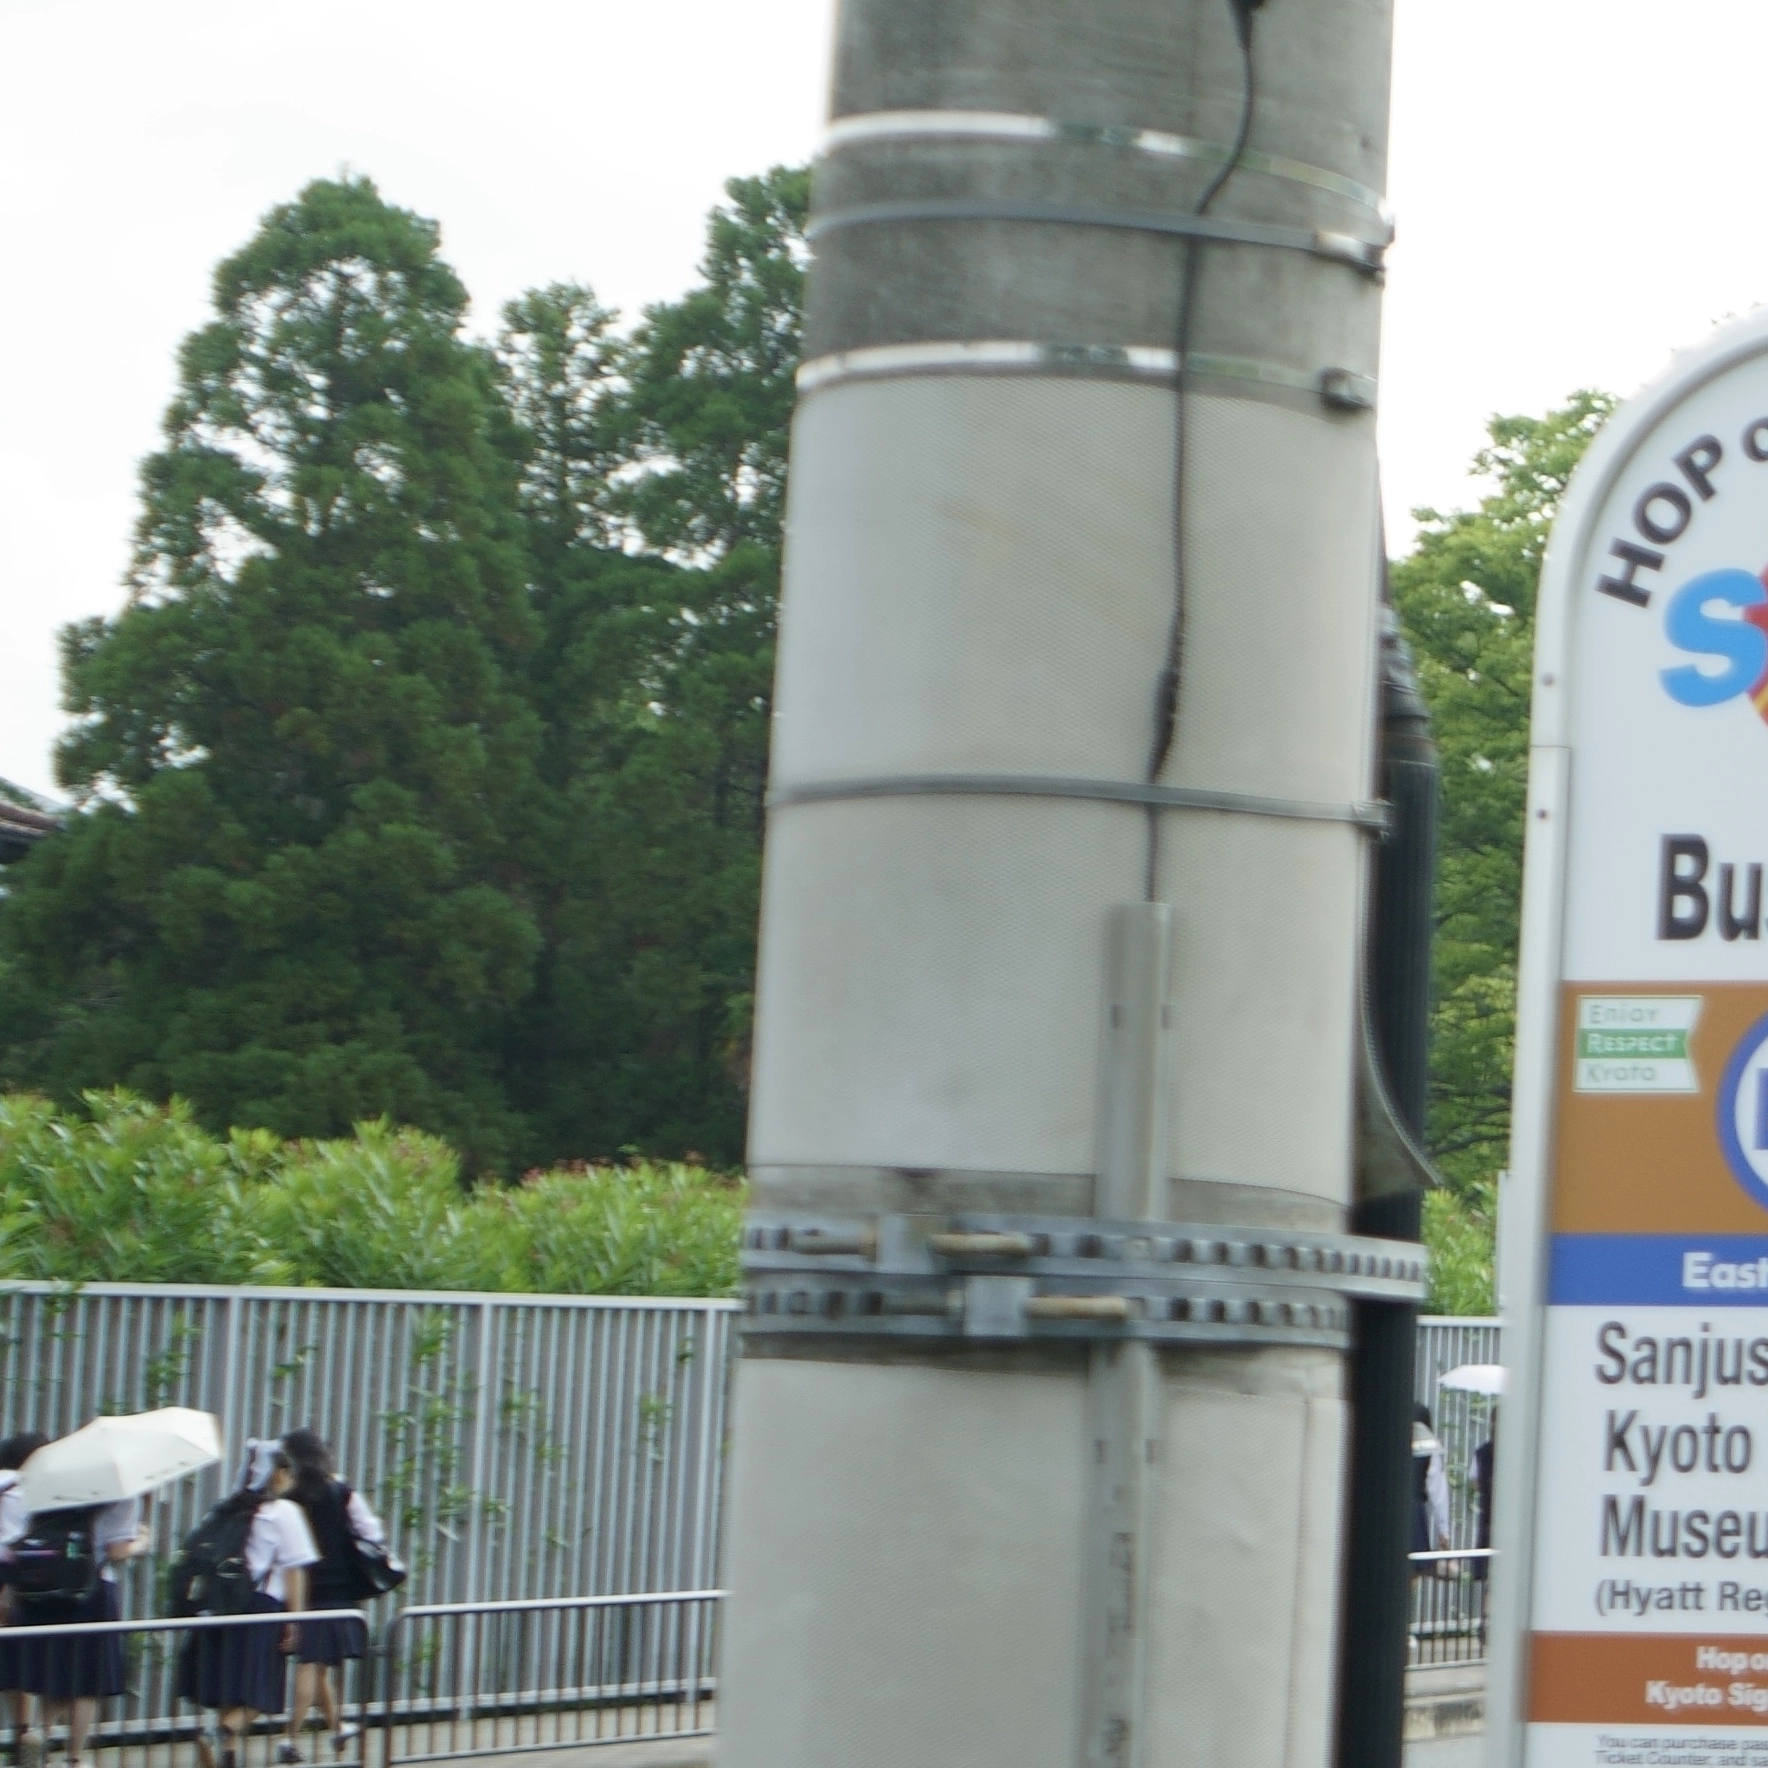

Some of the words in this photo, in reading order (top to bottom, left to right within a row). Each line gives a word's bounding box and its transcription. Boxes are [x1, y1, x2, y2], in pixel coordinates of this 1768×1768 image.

[1595, 434, 1724, 608] HOP
[1603, 1409, 1752, 1487] Kyoto
[1595, 1579, 1705, 1617] (Hyatt
[1696, 1646, 1746, 1675] Hop
[1646, 1681, 1722, 1710] Kyoto
